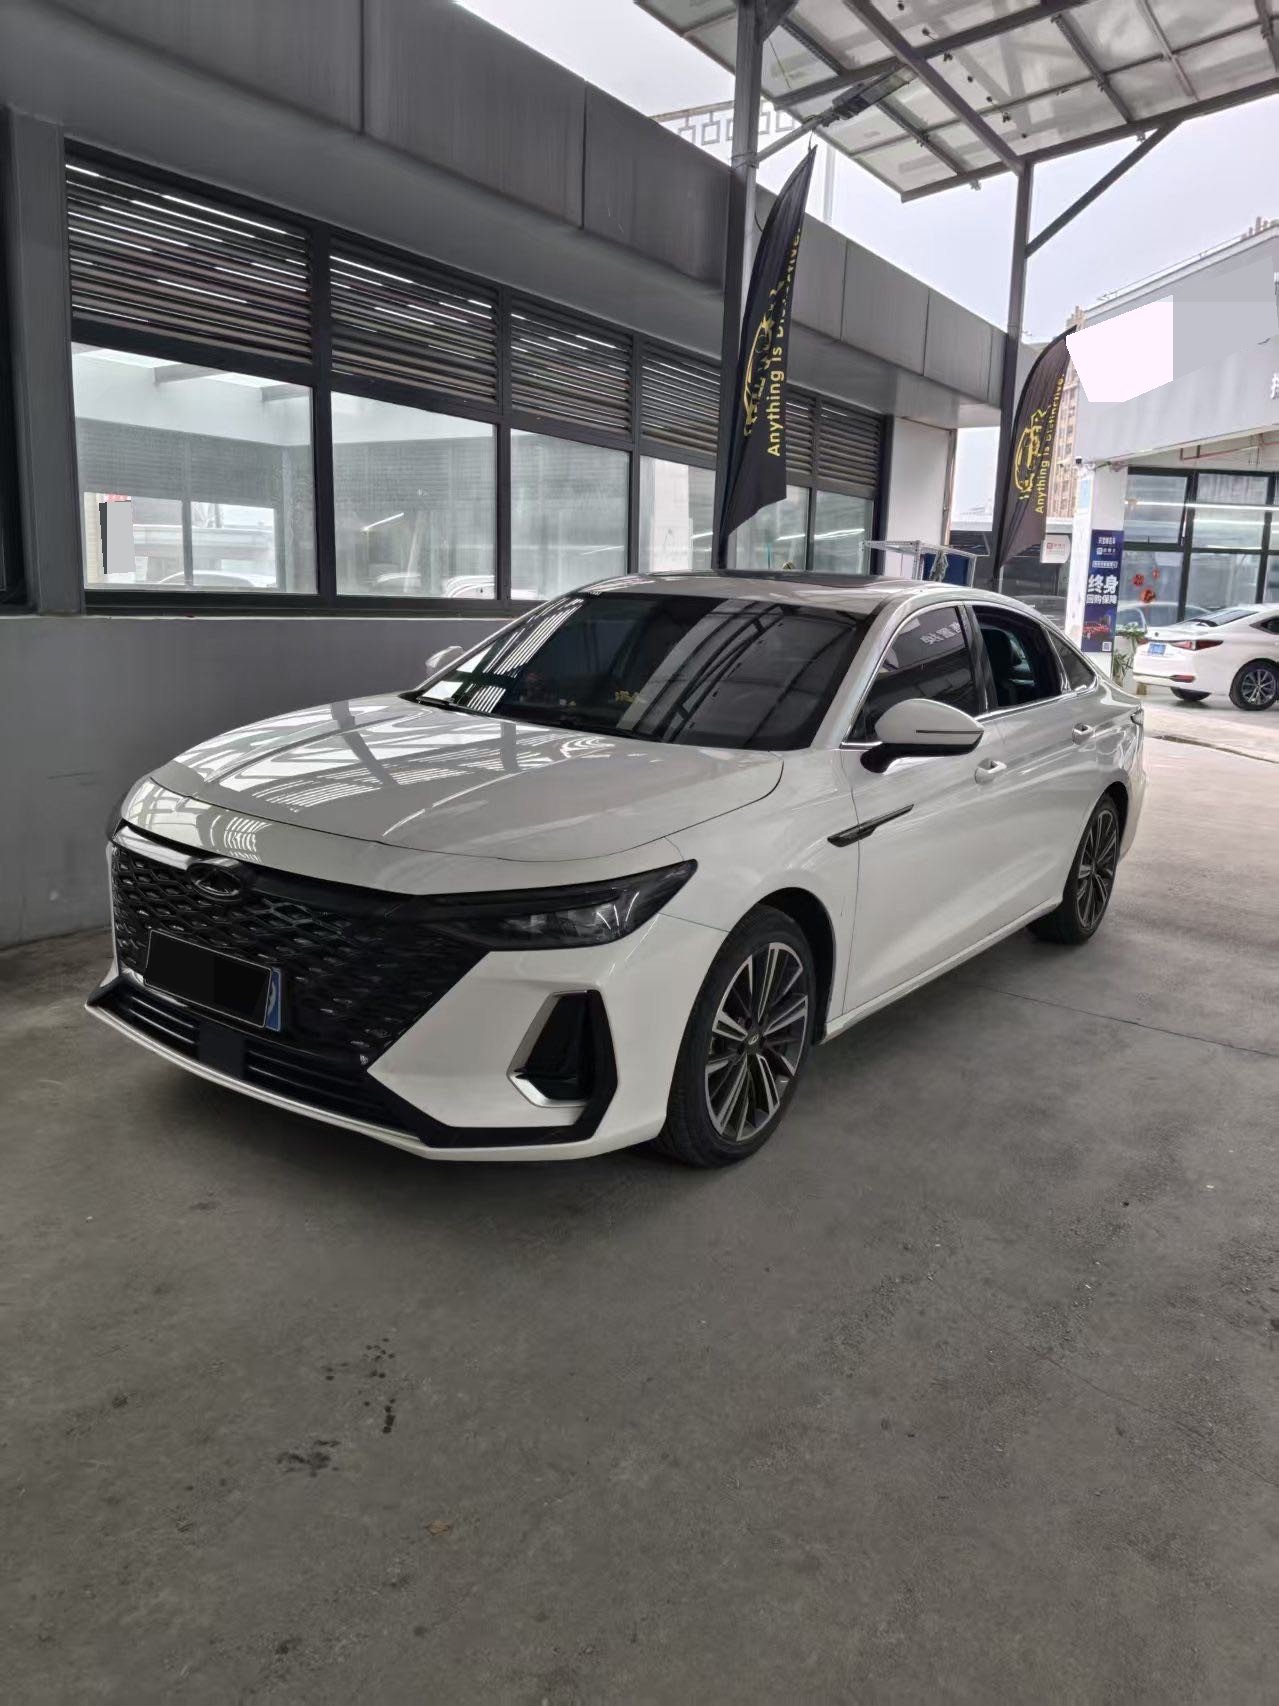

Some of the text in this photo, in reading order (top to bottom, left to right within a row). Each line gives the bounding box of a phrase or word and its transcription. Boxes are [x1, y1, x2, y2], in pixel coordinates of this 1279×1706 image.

[771, 346, 783, 362] is
[766, 370, 785, 457] Anything
[1034, 460, 1050, 514] Anything
[1087, 574, 1119, 594] 终身
